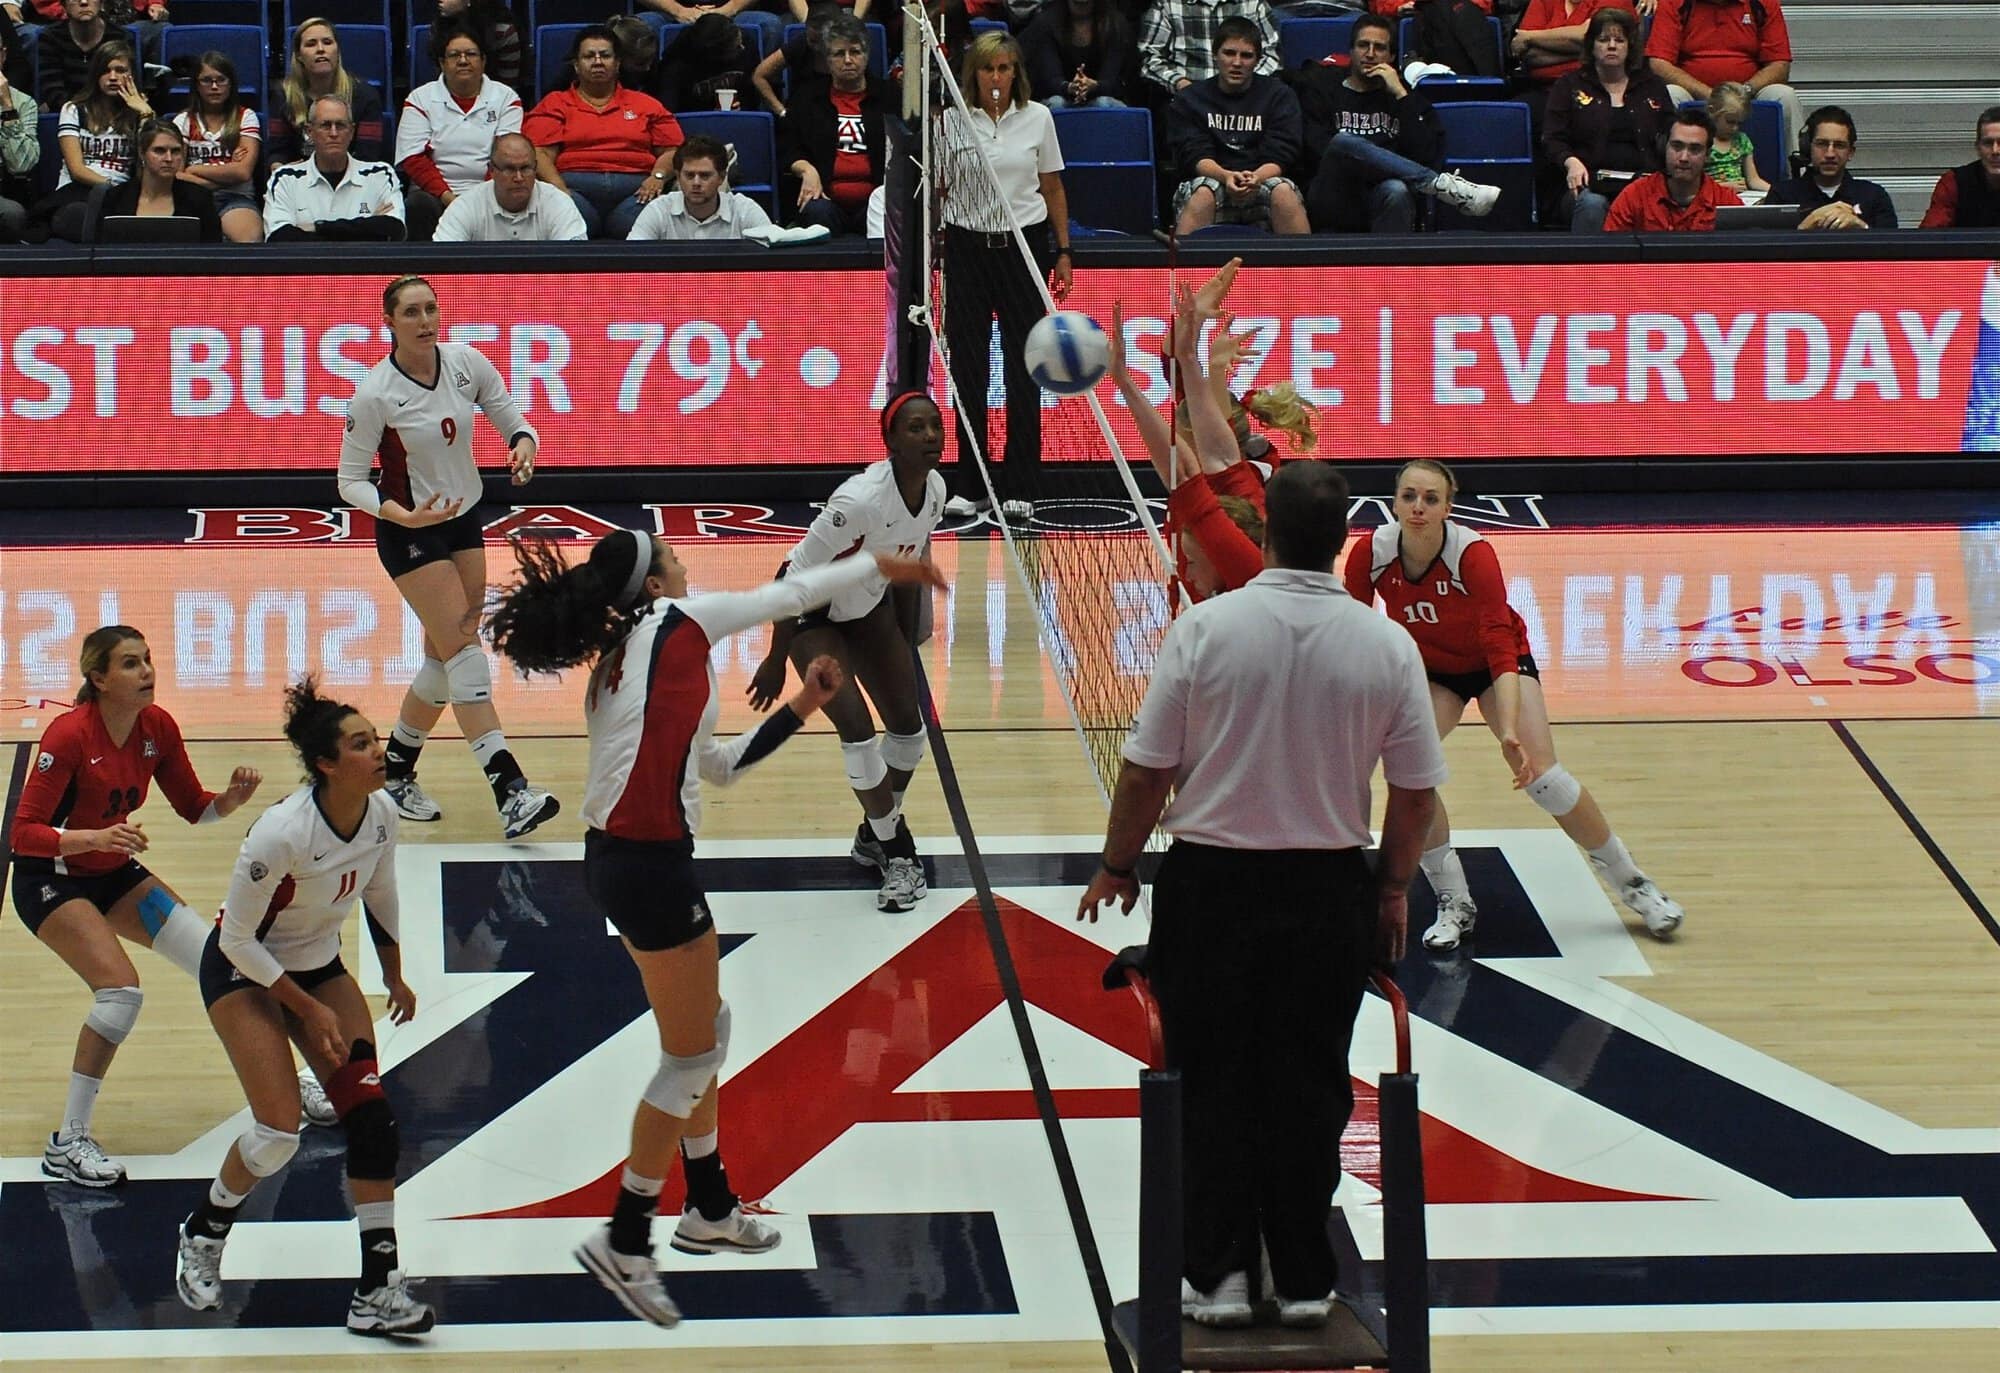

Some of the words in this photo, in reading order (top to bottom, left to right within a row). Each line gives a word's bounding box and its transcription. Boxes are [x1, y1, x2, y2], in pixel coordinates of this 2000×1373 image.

[1207, 112, 1262, 131] ARIZONA
[0, 325, 136, 420] ST
[170, 324, 574, 419] BUSR
[606, 320, 764, 415] 79¢
[1432, 309, 1962, 405] EVERYDAY
[440, 417, 457, 447] 9
[183, 502, 812, 544] BAR
[1436, 581, 1449, 596] U
[1403, 601, 1439, 624] 10
[1681, 653, 2000, 688] OLSO
[332, 870, 357, 904] 11
